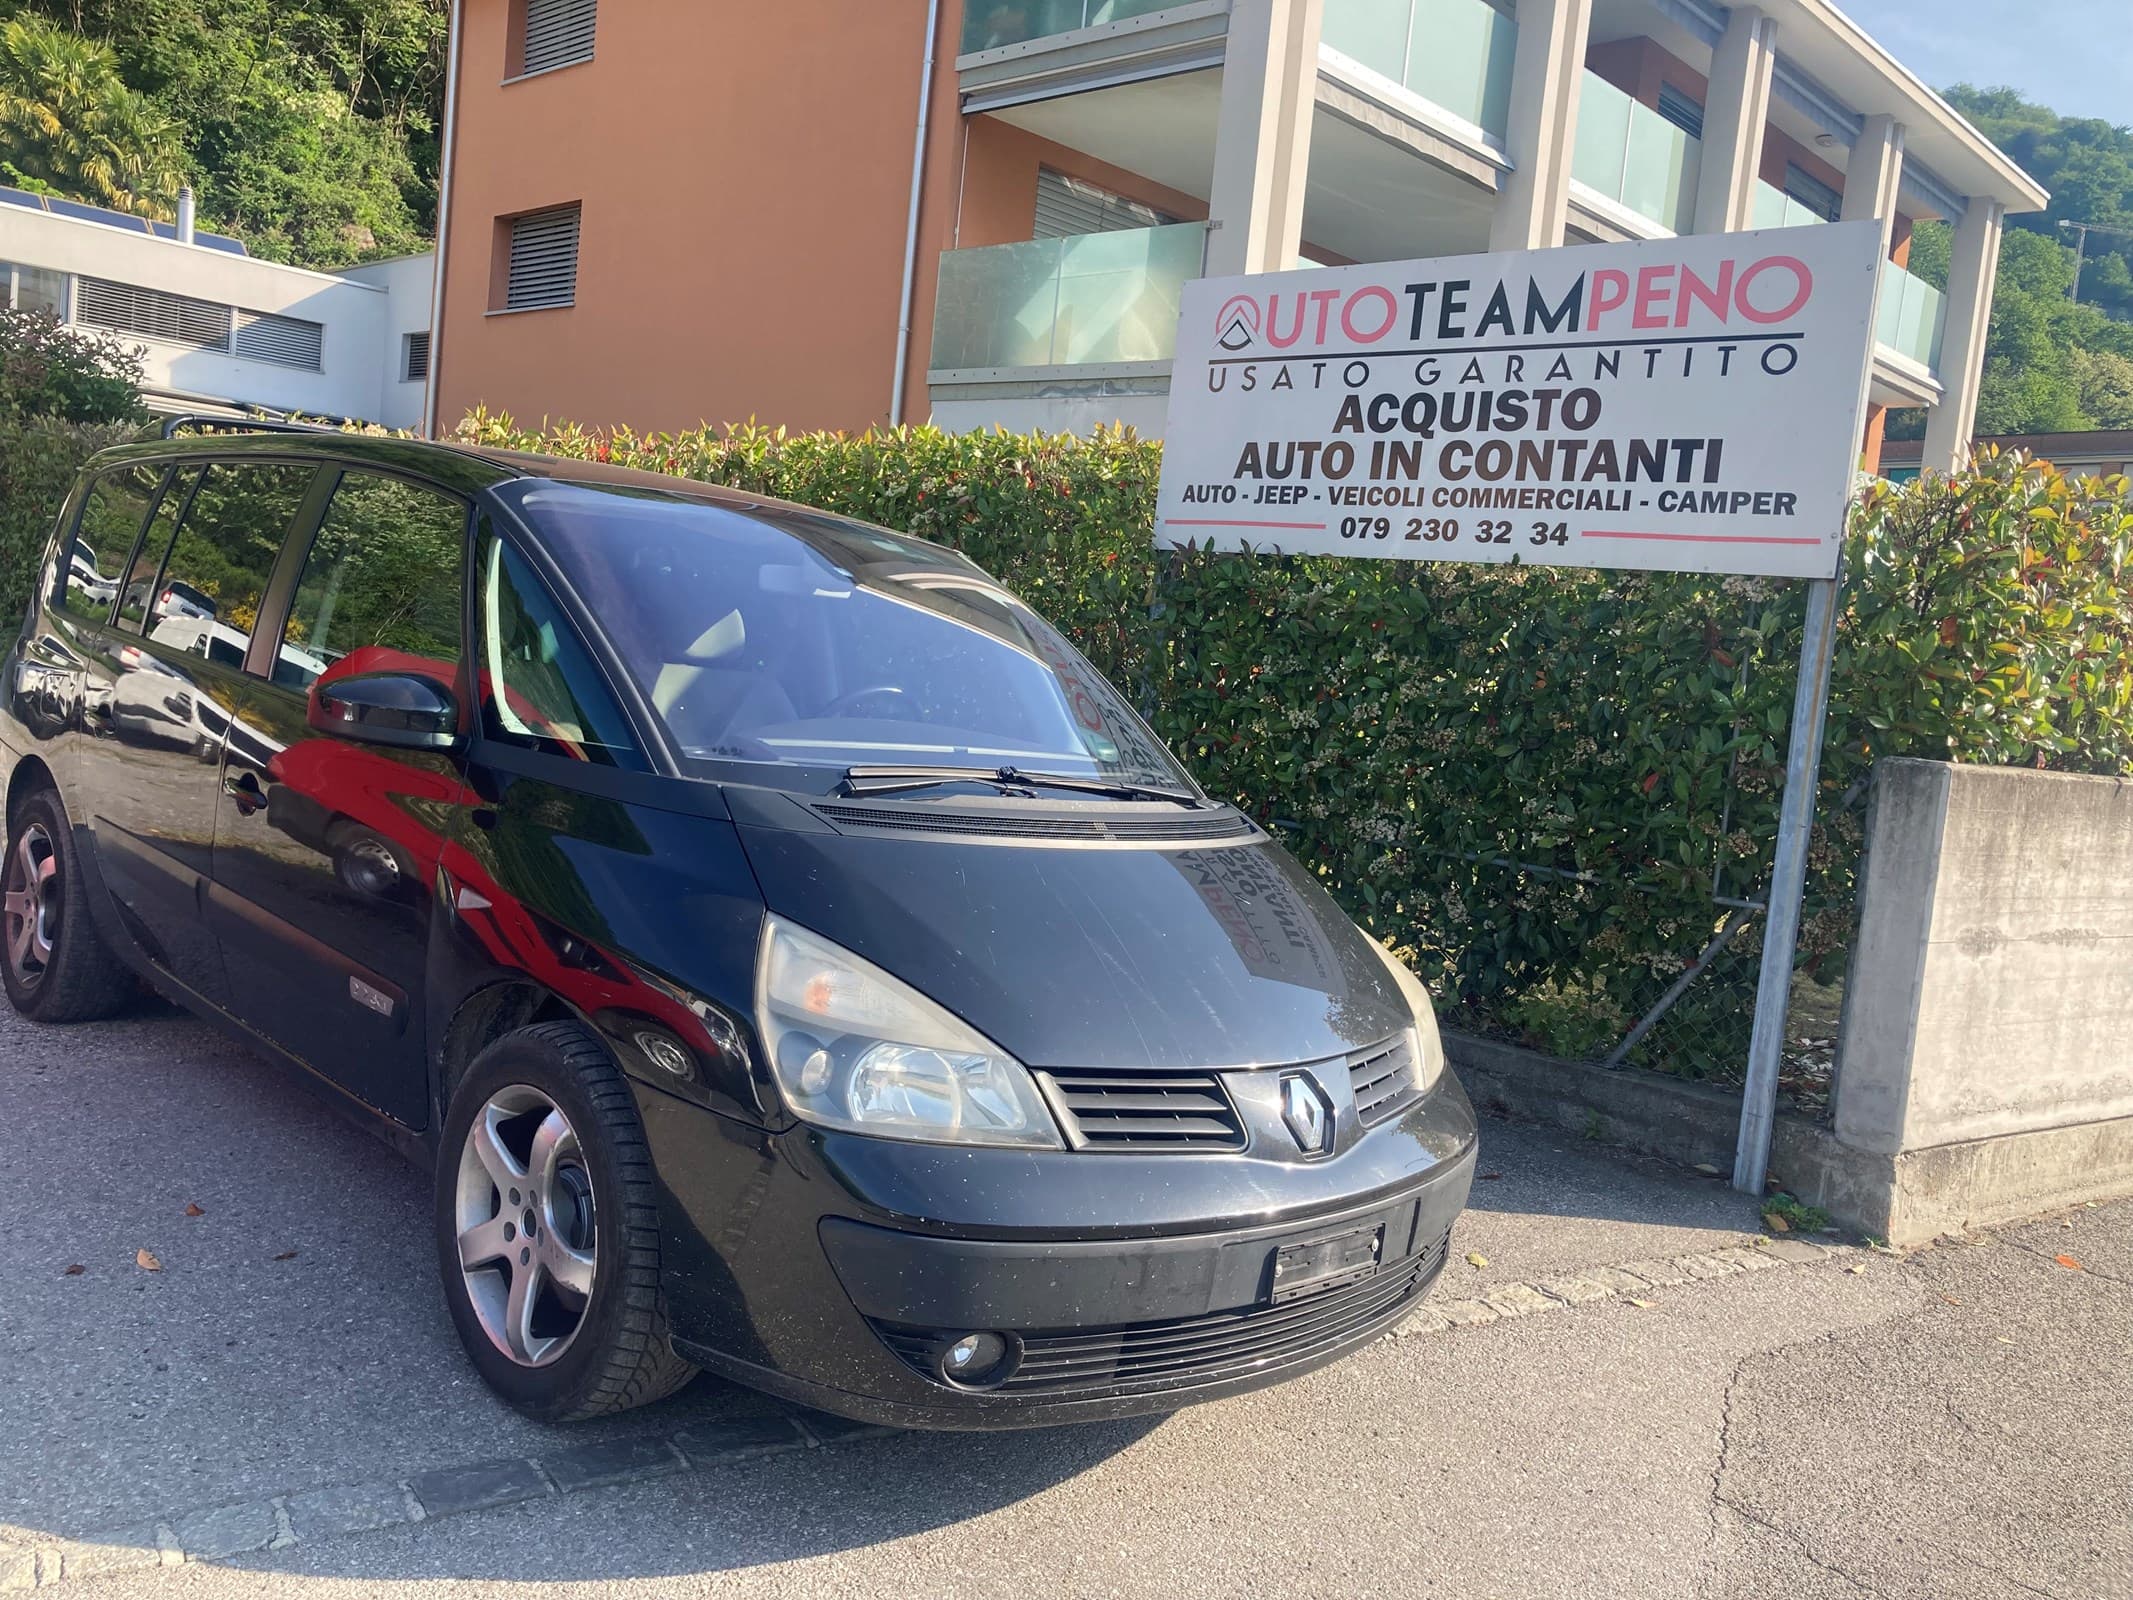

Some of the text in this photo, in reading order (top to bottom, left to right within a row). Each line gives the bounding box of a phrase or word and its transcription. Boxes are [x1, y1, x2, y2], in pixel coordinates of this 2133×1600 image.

[1208, 343, 1799, 393] USATO GARANTITO
[1331, 387, 1602, 440] ACQUISTO
[1233, 438, 1724, 484] AUTO IN CONTANTI
[1182, 484, 1237, 504] AUTO
[1253, 485, 1309, 505] JEEP
[1328, 486, 1425, 508] VEICOLI
[1432, 487, 1632, 511] COMMERCIALI
[1657, 490, 1798, 516] CAMPER
[1340, 516, 1569, 547] 079 230 32 34
